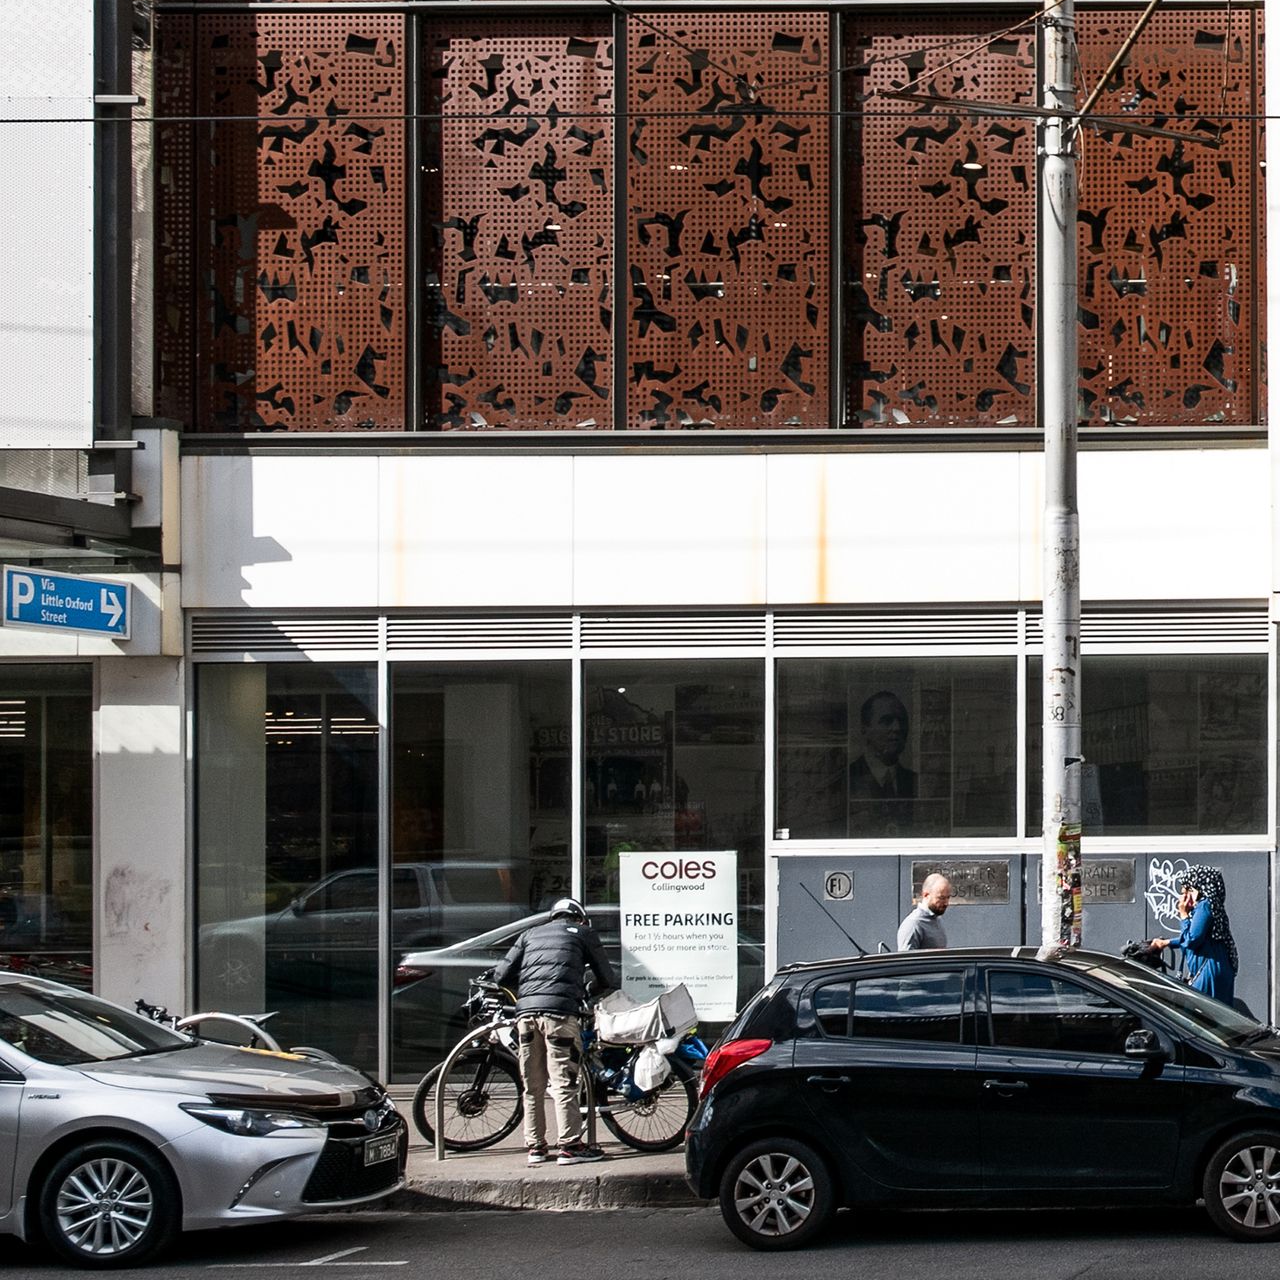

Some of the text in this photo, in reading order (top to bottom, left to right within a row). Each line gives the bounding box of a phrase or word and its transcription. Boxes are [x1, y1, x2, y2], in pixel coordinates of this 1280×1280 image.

[41, 578, 55, 591] Via
[12, 574, 35, 619] P
[41, 594, 94, 611] Little Oxford
[41, 609, 67, 624] Street
[642, 859, 717, 880] coles
[1080, 866, 1118, 879] RANT
[652, 883, 705, 892] Collingwood
[950, 884, 991, 898] OSTER
[1085, 883, 1118, 897] STER
[625, 912, 734, 926] FREE PARKING
[635, 932, 646, 940] For
[663, 932, 684, 940] hours
[686, 932, 708, 940] when
[709, 933, 724, 941] you
[629, 944, 651, 952] spend
[653, 944, 665, 952] $15
